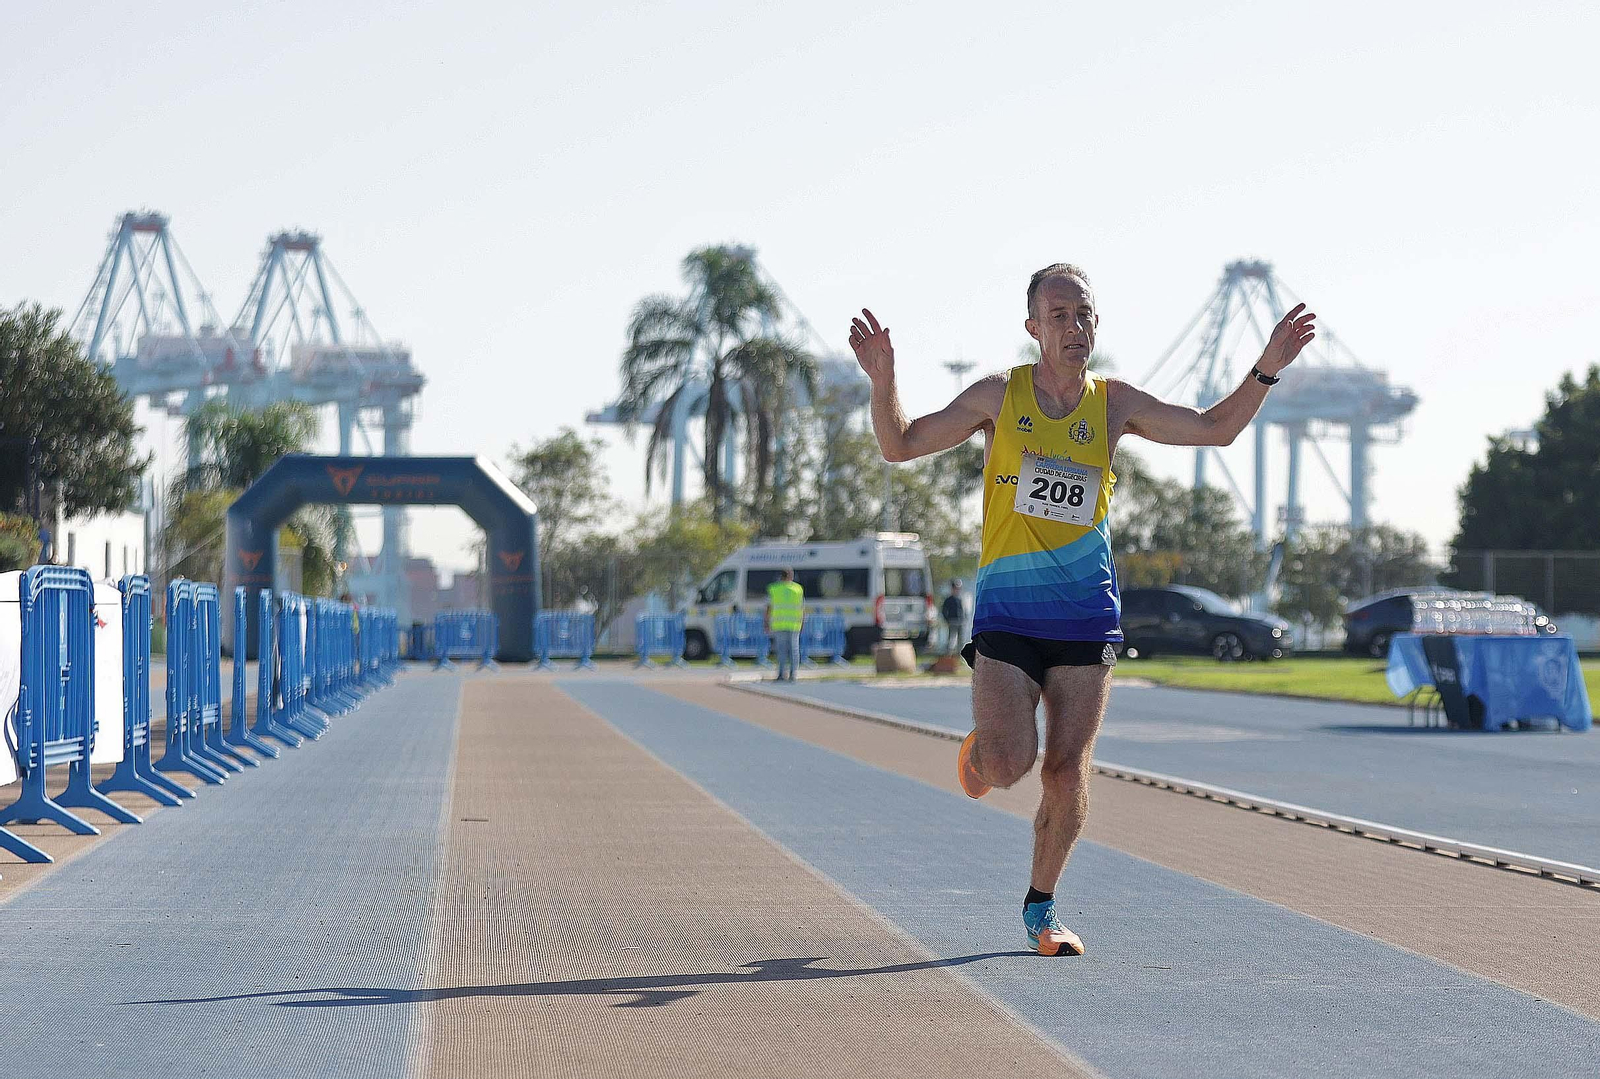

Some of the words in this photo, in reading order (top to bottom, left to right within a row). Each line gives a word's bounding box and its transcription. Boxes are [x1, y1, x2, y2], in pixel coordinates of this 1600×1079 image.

[1035, 467, 1054, 476] CIUDAD
[1062, 472, 1088, 482] ALGECIRAS
[1029, 477, 1085, 507] 208
